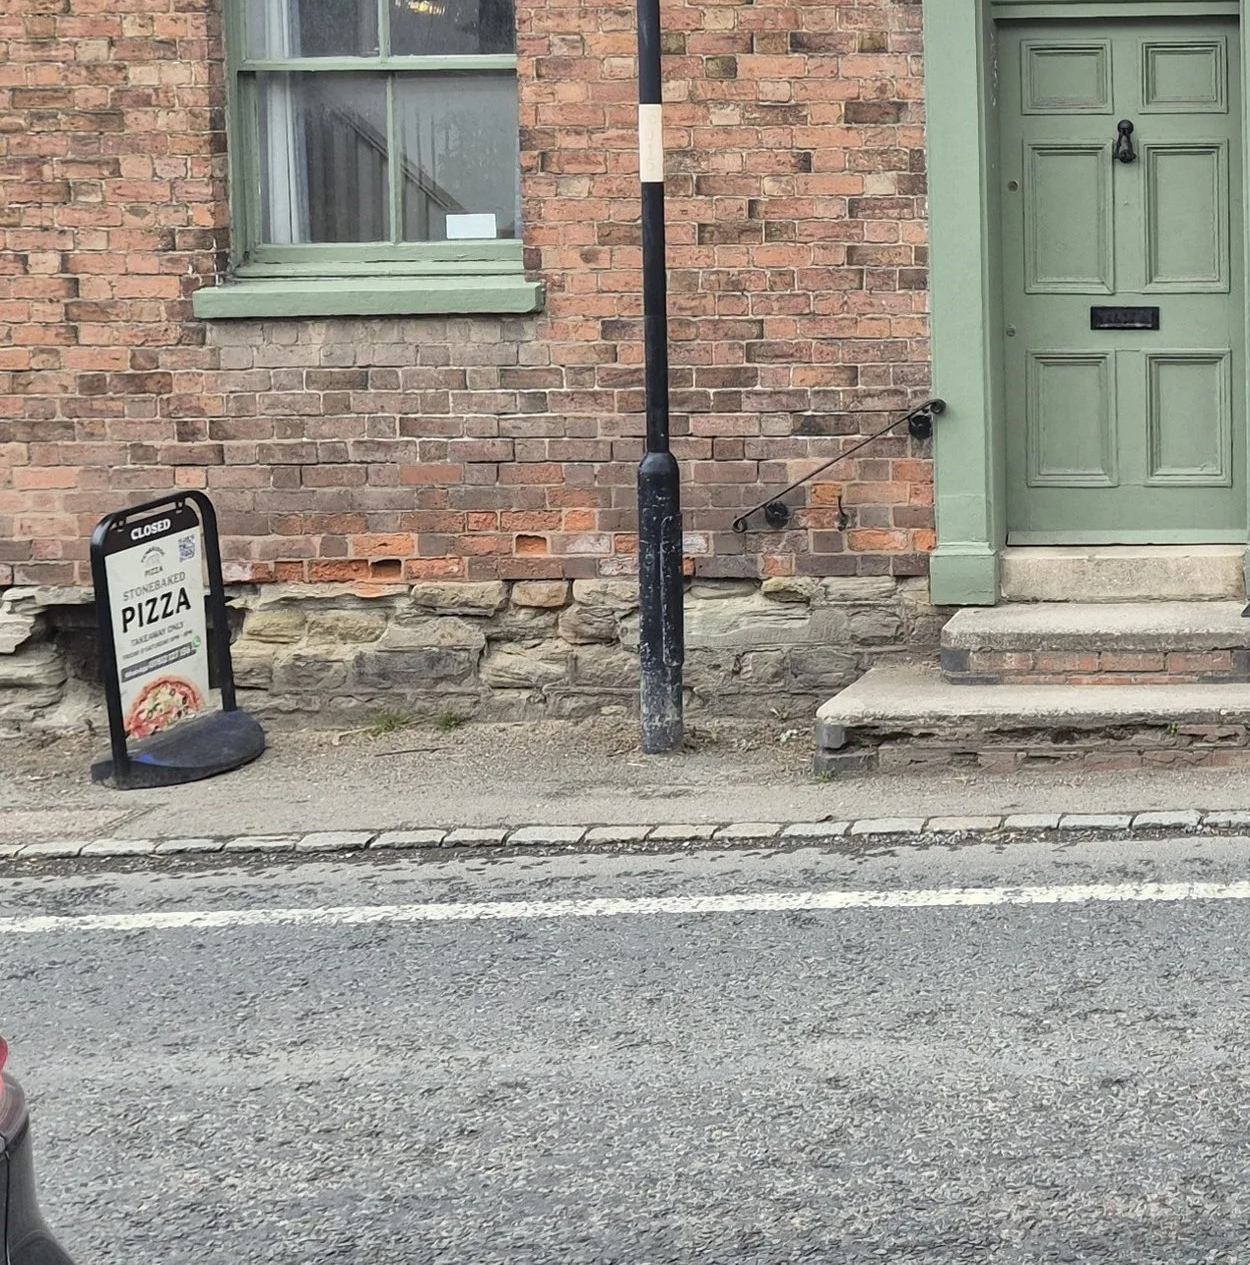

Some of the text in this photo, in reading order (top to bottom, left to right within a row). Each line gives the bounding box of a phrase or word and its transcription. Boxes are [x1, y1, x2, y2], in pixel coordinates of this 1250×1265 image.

[130, 518, 171, 540] CLOSED
[123, 571, 186, 601] STONEBAKED
[121, 587, 191, 633] PIZZA
